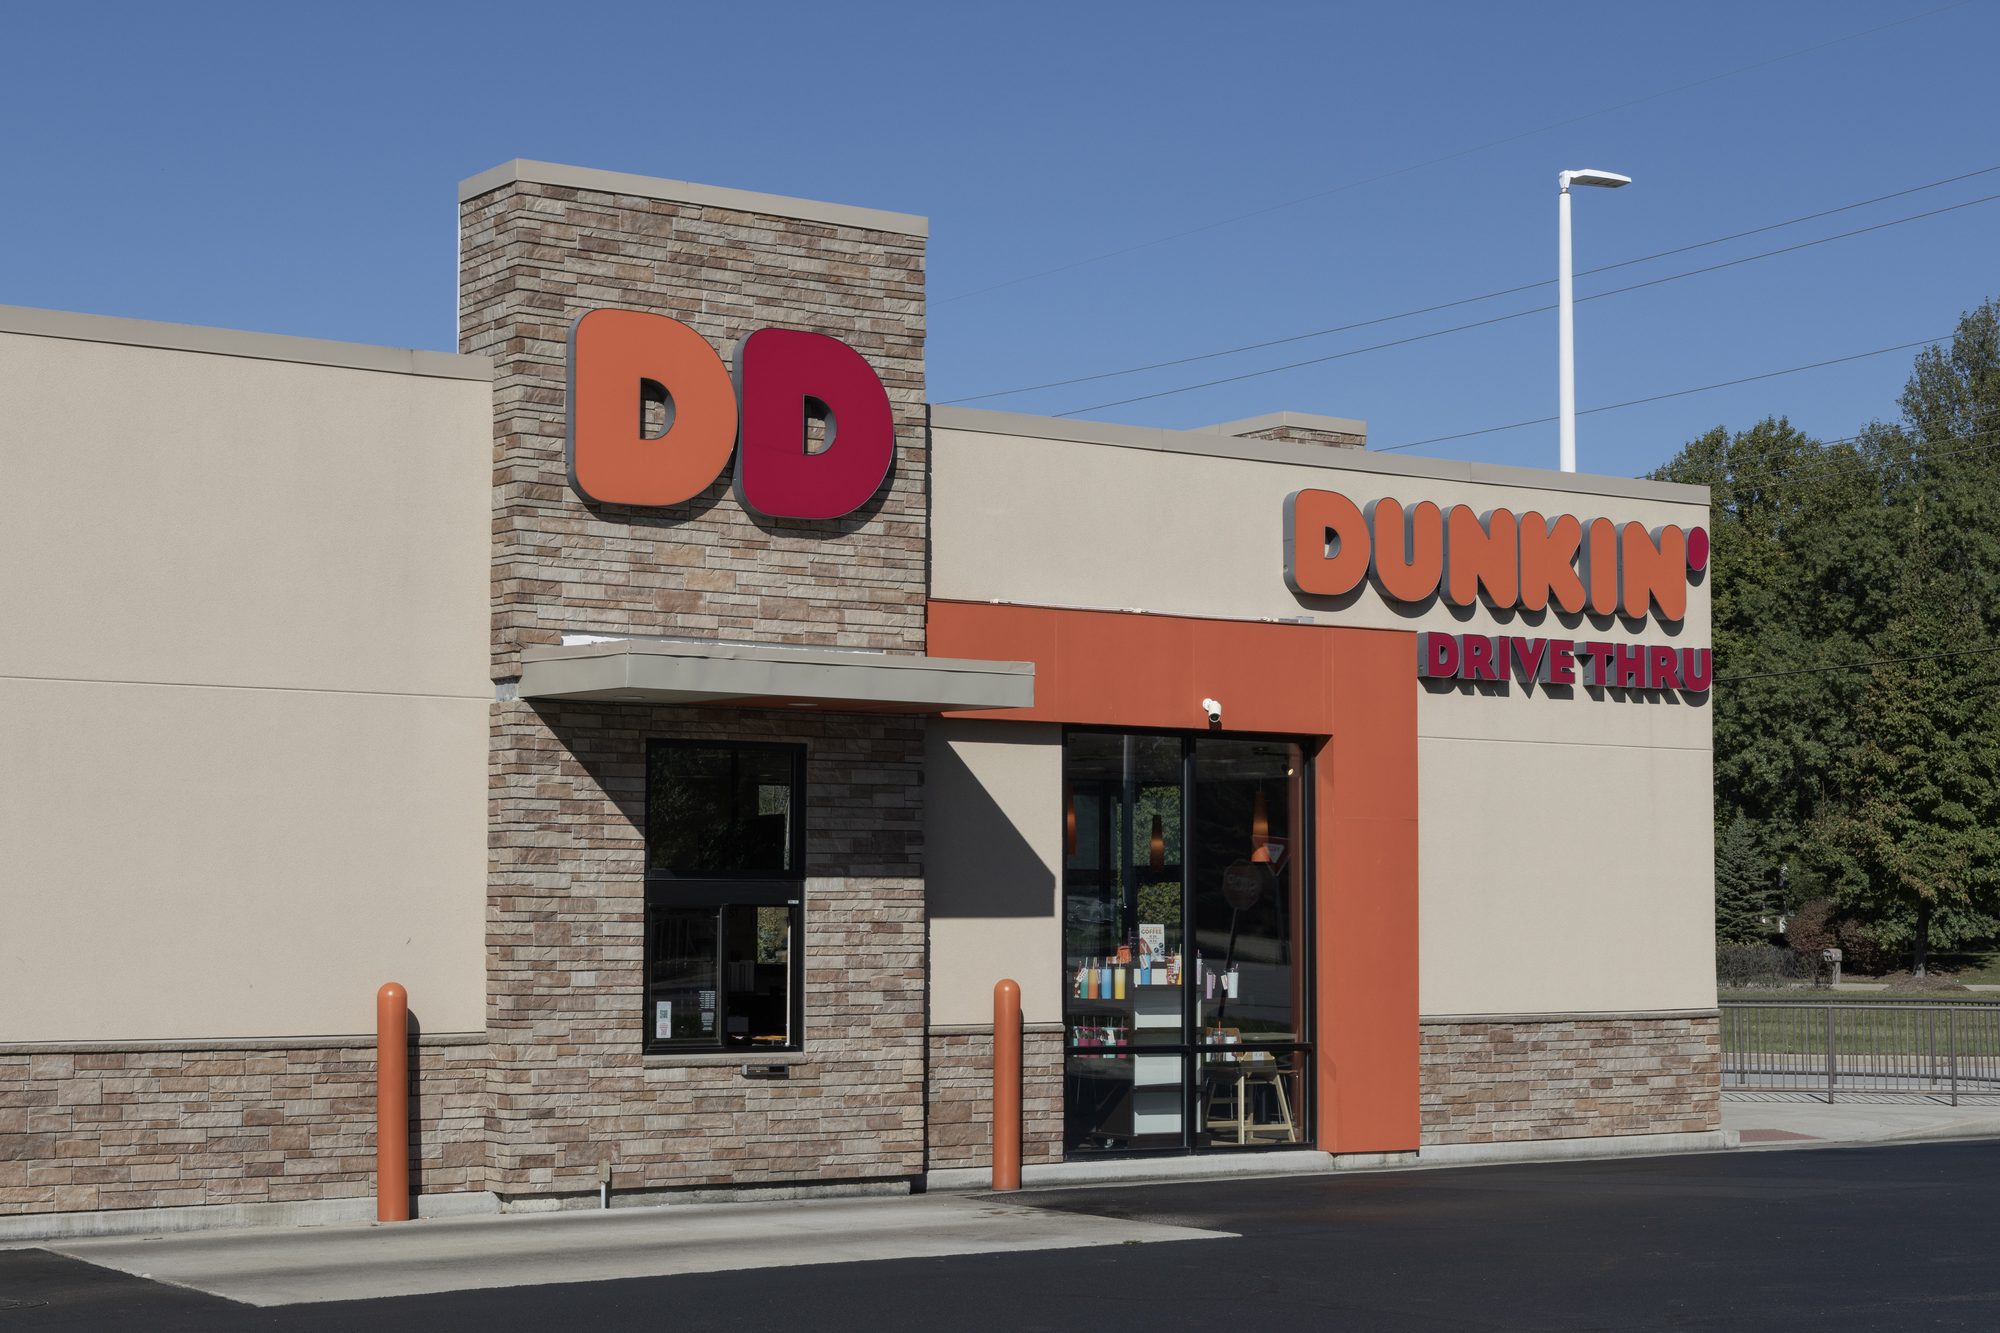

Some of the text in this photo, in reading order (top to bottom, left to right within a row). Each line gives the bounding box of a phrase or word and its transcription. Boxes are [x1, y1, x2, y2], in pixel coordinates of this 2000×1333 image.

[1292, 487, 1710, 622] DUNKIN'
[1426, 630, 1712, 693] DRIVE THRU
